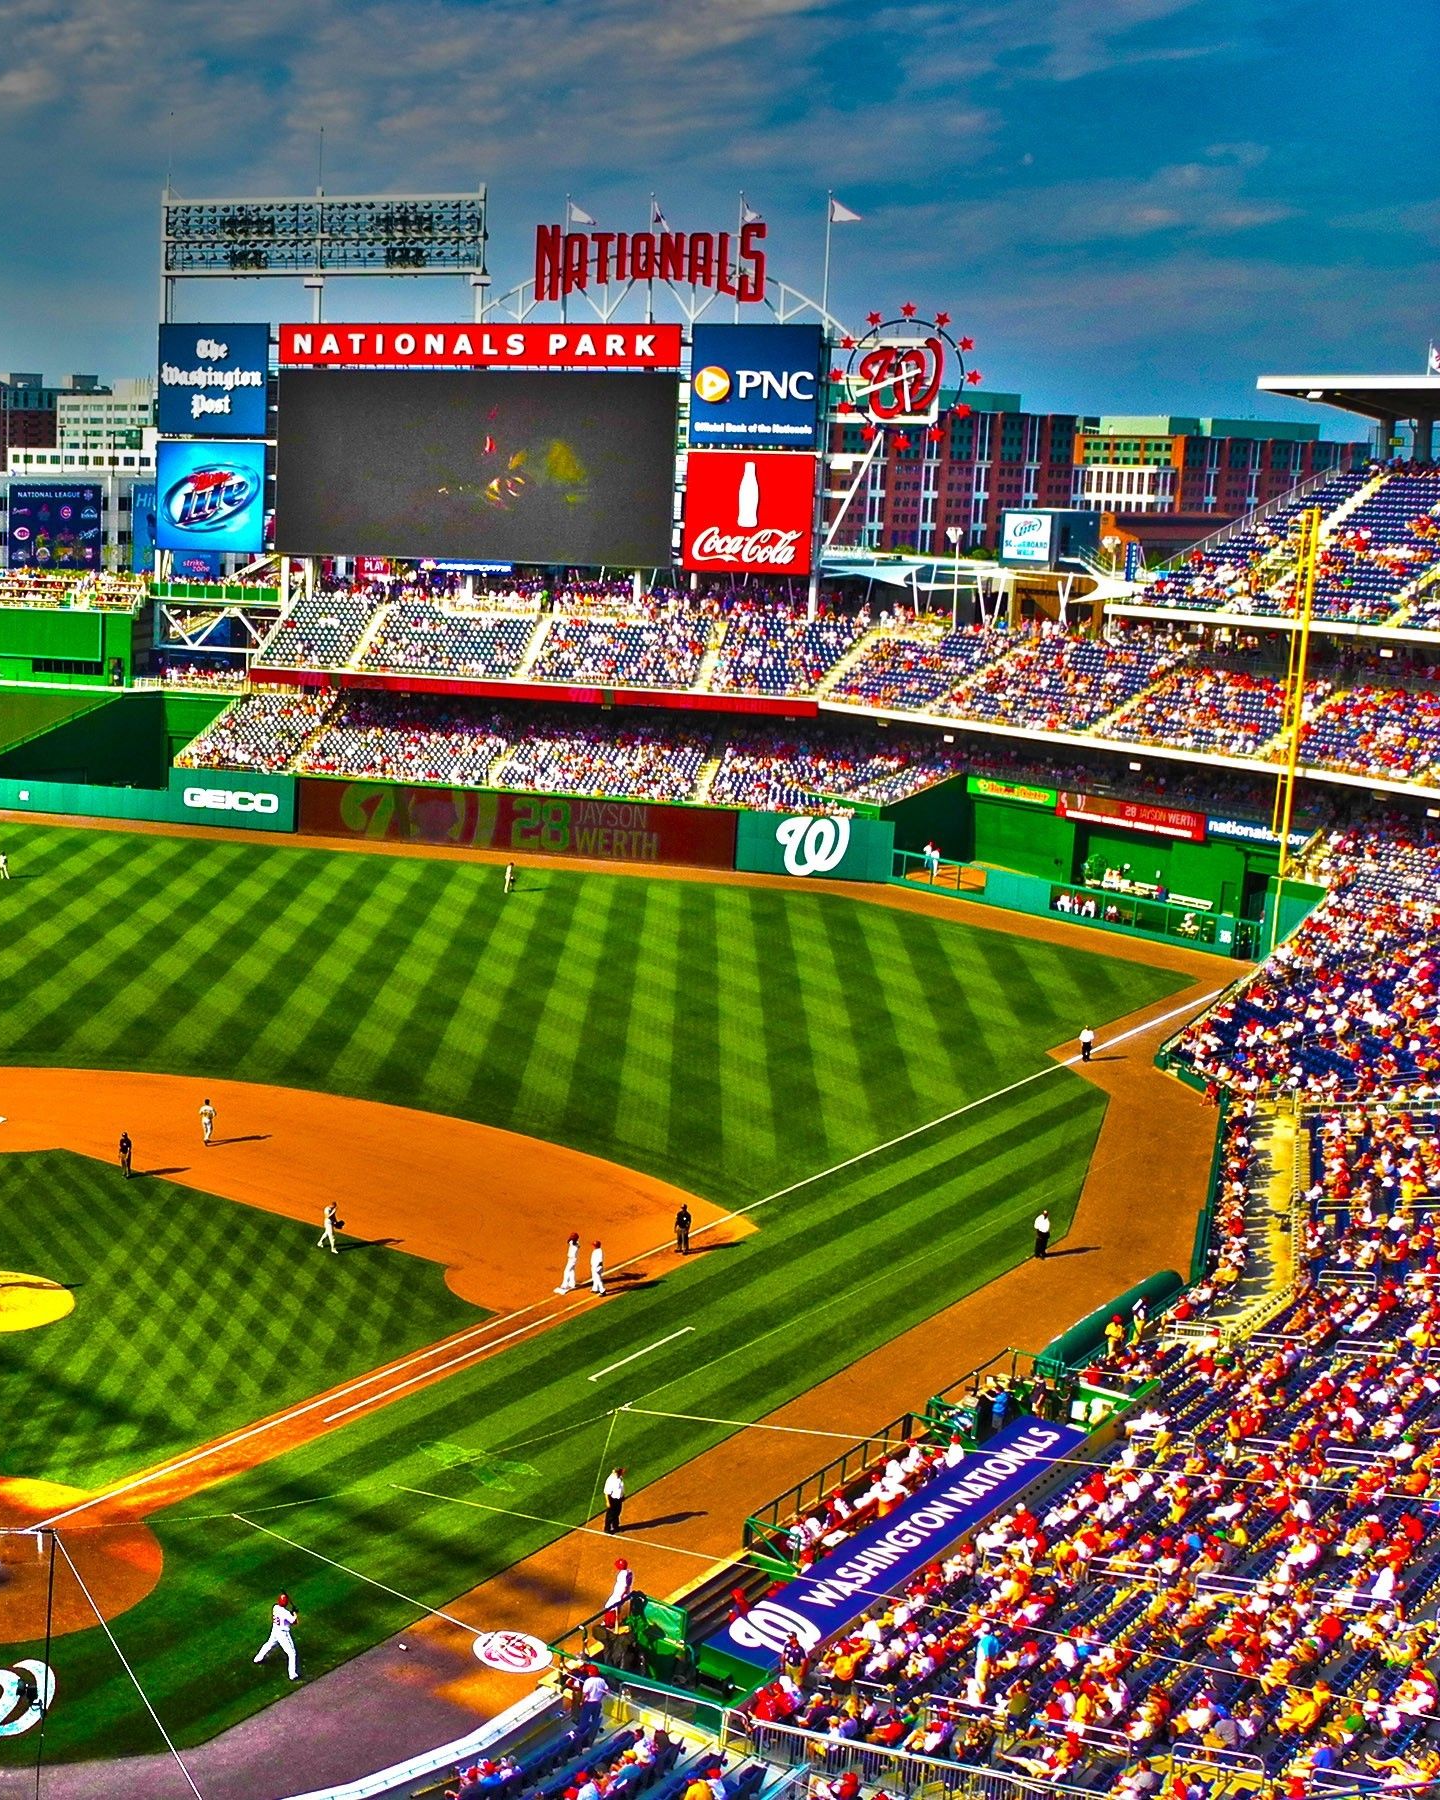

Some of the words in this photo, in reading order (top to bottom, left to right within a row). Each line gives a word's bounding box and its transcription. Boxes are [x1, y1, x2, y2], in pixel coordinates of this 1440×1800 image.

[535, 223, 766, 302] NATIONALS
[196, 339, 228, 361] The
[293, 334, 525, 355] NATIONALS
[548, 334, 656, 356] PARK
[161, 362, 262, 391] Washington
[736, 370, 814, 400] PNC
[191, 394, 230, 419] Post
[692, 526, 803, 565] Coca-Cola
[364, 562, 385, 572] PLAY
[184, 787, 279, 813] GEICO
[1125, 806, 1137, 817] 28
[510, 799, 570, 852] 28
[575, 801, 647, 828] JAYSON
[575, 826, 659, 859] WERTH
[799, 1493, 962, 1607] WASHINGTON
[949, 1427, 1060, 1506] NATIONALS
